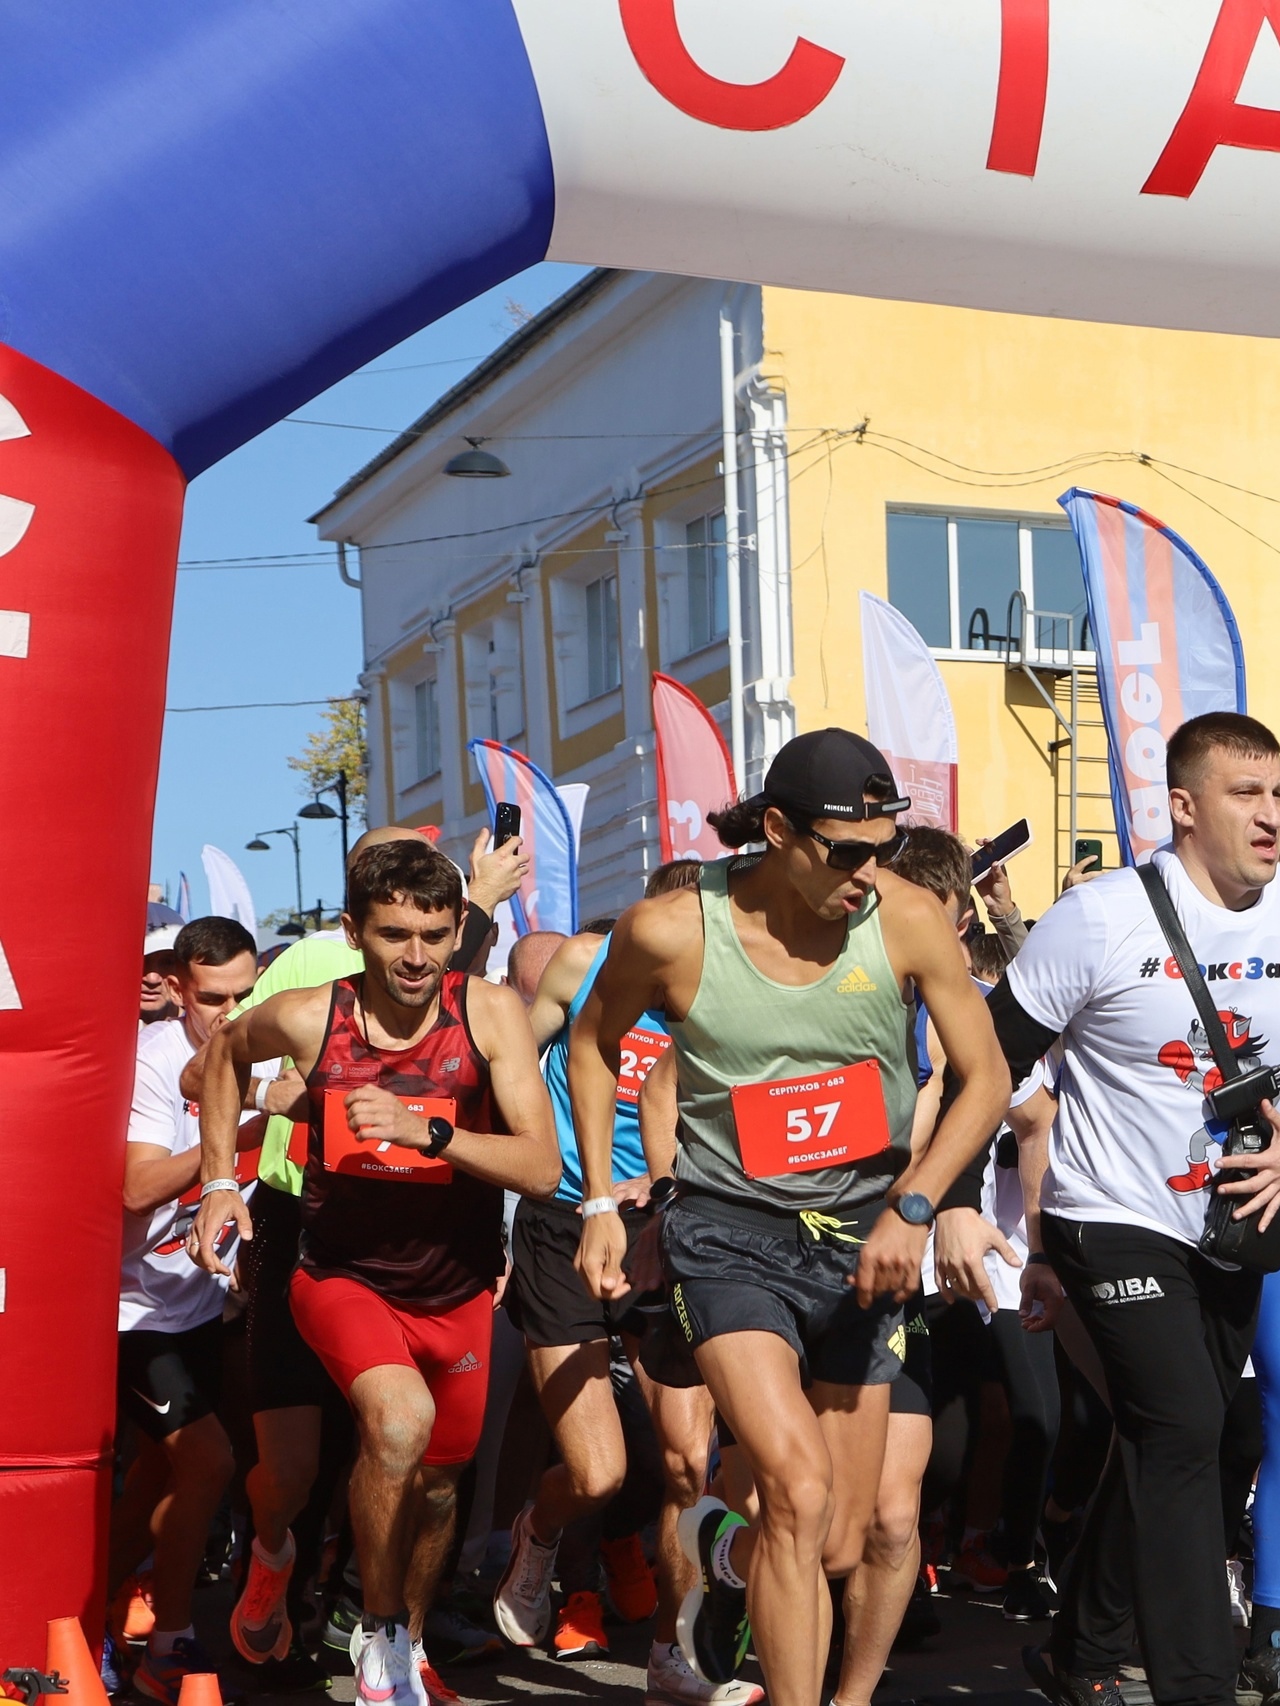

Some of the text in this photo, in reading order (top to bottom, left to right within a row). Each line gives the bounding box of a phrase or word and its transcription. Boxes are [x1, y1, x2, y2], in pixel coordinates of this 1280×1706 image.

[836, 982, 877, 993] adidas
[769, 1081, 820, 1097] СЕРПУХОВ
[827, 1076, 845, 1088] 683
[408, 1104, 424, 1112] 683
[786, 1101, 842, 1143] 57
[788, 1146, 848, 1164] #БОКСЗАБЕГ
[361, 1163, 414, 1175] #БОКСЗАБЕГ
[1117, 1276, 1163, 1297] IBA
[447, 1361, 483, 1374] adidas
